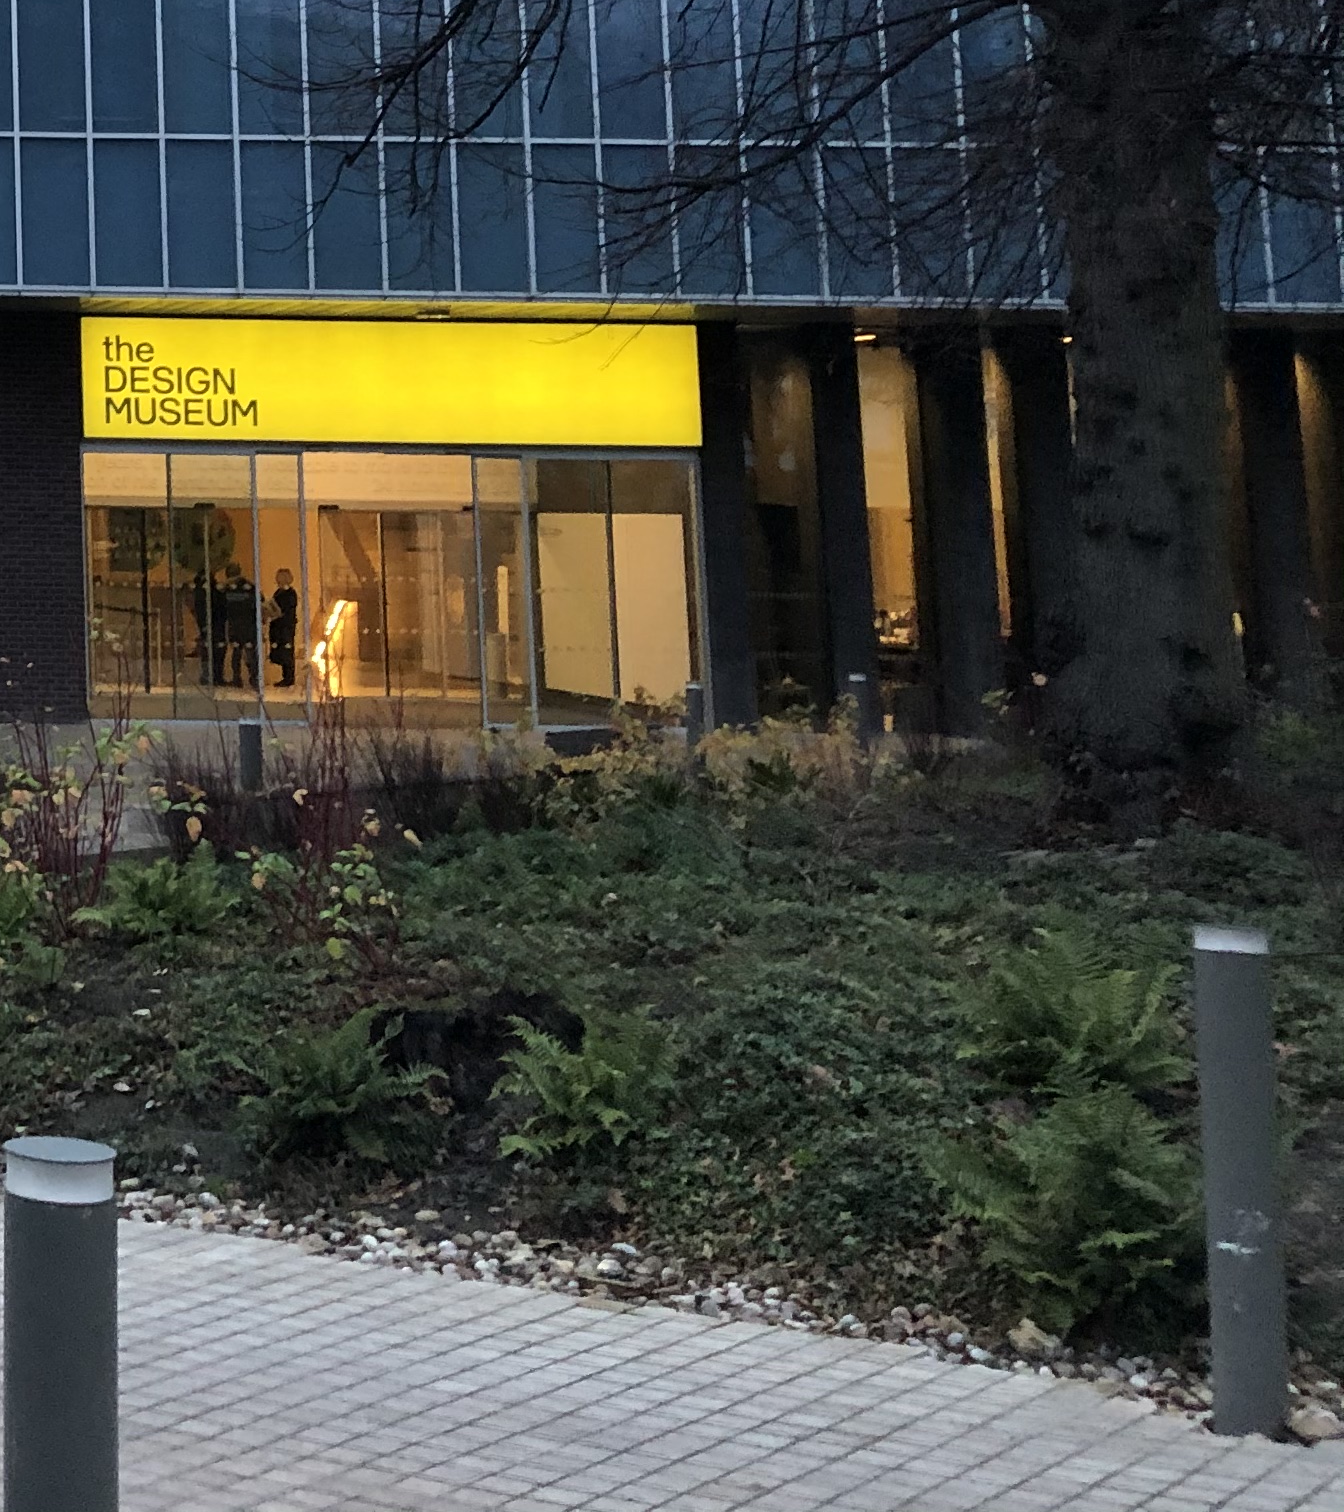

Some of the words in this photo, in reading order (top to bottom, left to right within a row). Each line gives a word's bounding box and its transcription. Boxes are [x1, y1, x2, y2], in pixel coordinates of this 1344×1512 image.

[102, 335, 154, 362] the
[104, 366, 235, 395] DESIGN
[105, 397, 258, 426] MUSEUM
